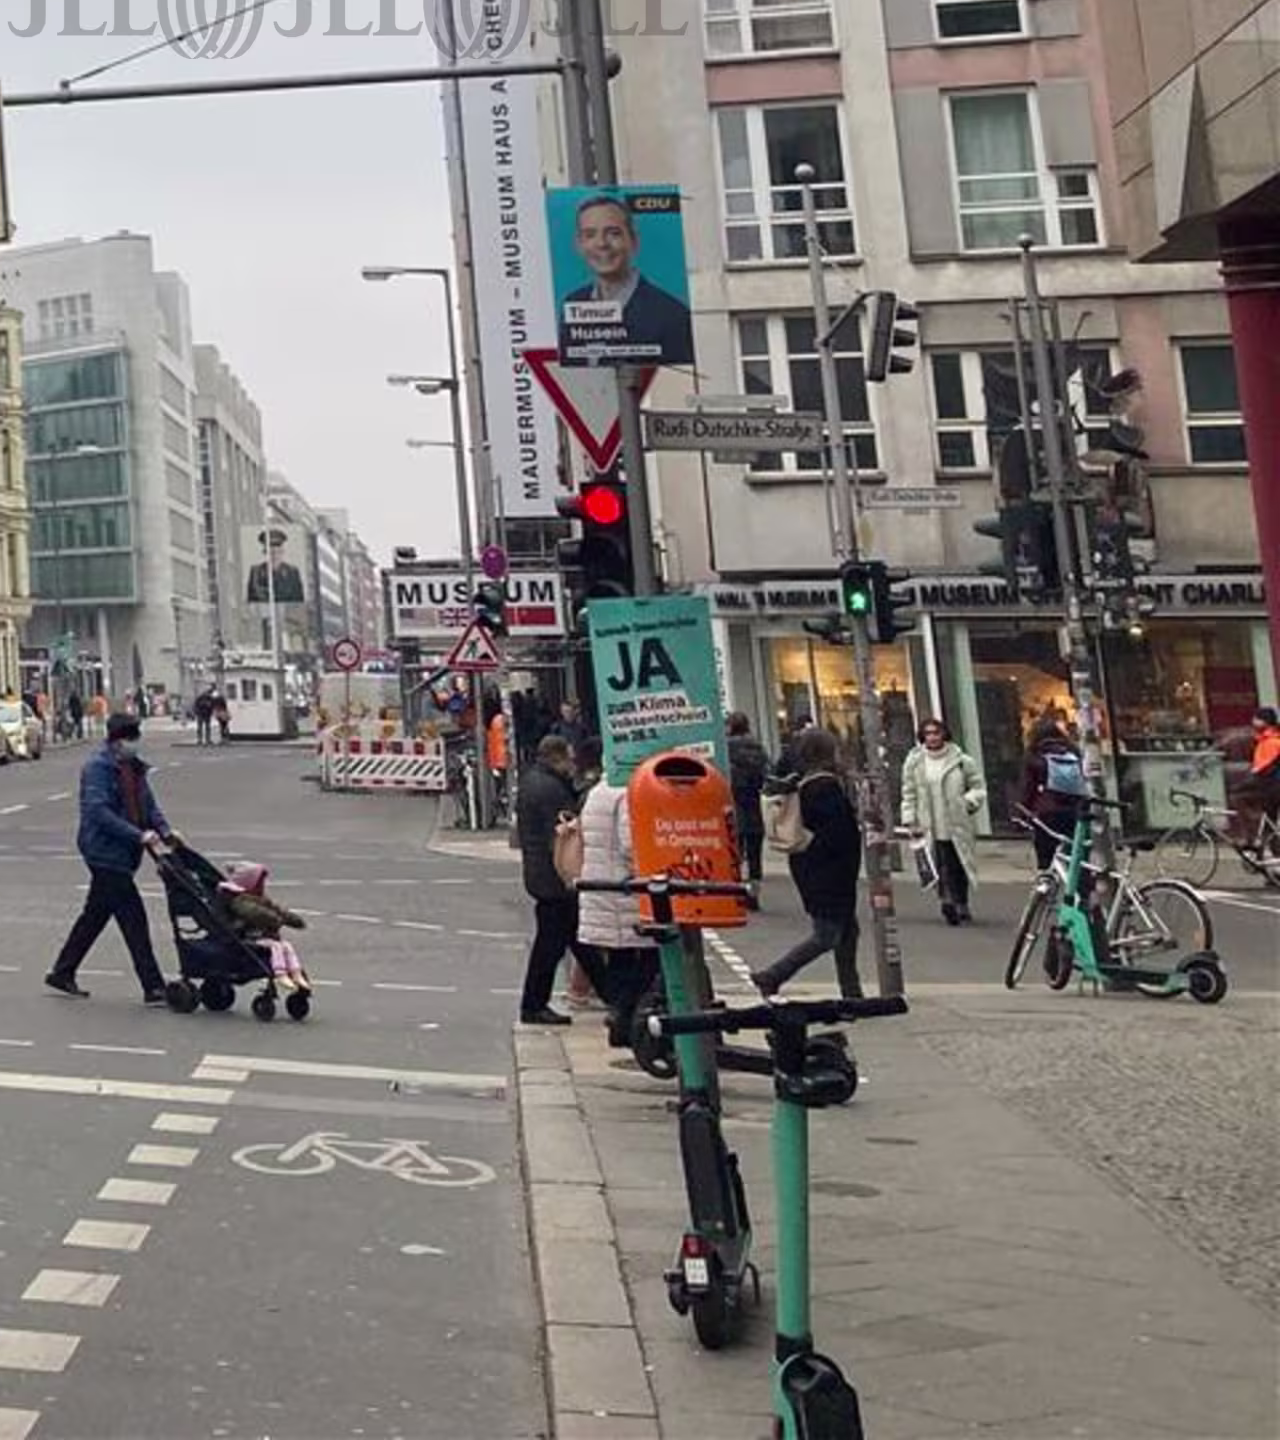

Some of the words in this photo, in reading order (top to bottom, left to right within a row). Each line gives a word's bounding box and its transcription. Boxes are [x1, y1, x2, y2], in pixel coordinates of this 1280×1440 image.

[492, 102, 513, 165] HAUS
[634, 196, 672, 210] CDU
[498, 175, 522, 278] MUSEUM
[569, 305, 617, 319] Timur
[570, 326, 628, 340] Husein
[920, 583, 1019, 606] MUSEUM
[1181, 582, 1266, 605] CHARLI
[606, 636, 684, 692] JA
[639, 694, 687, 711] Klima
